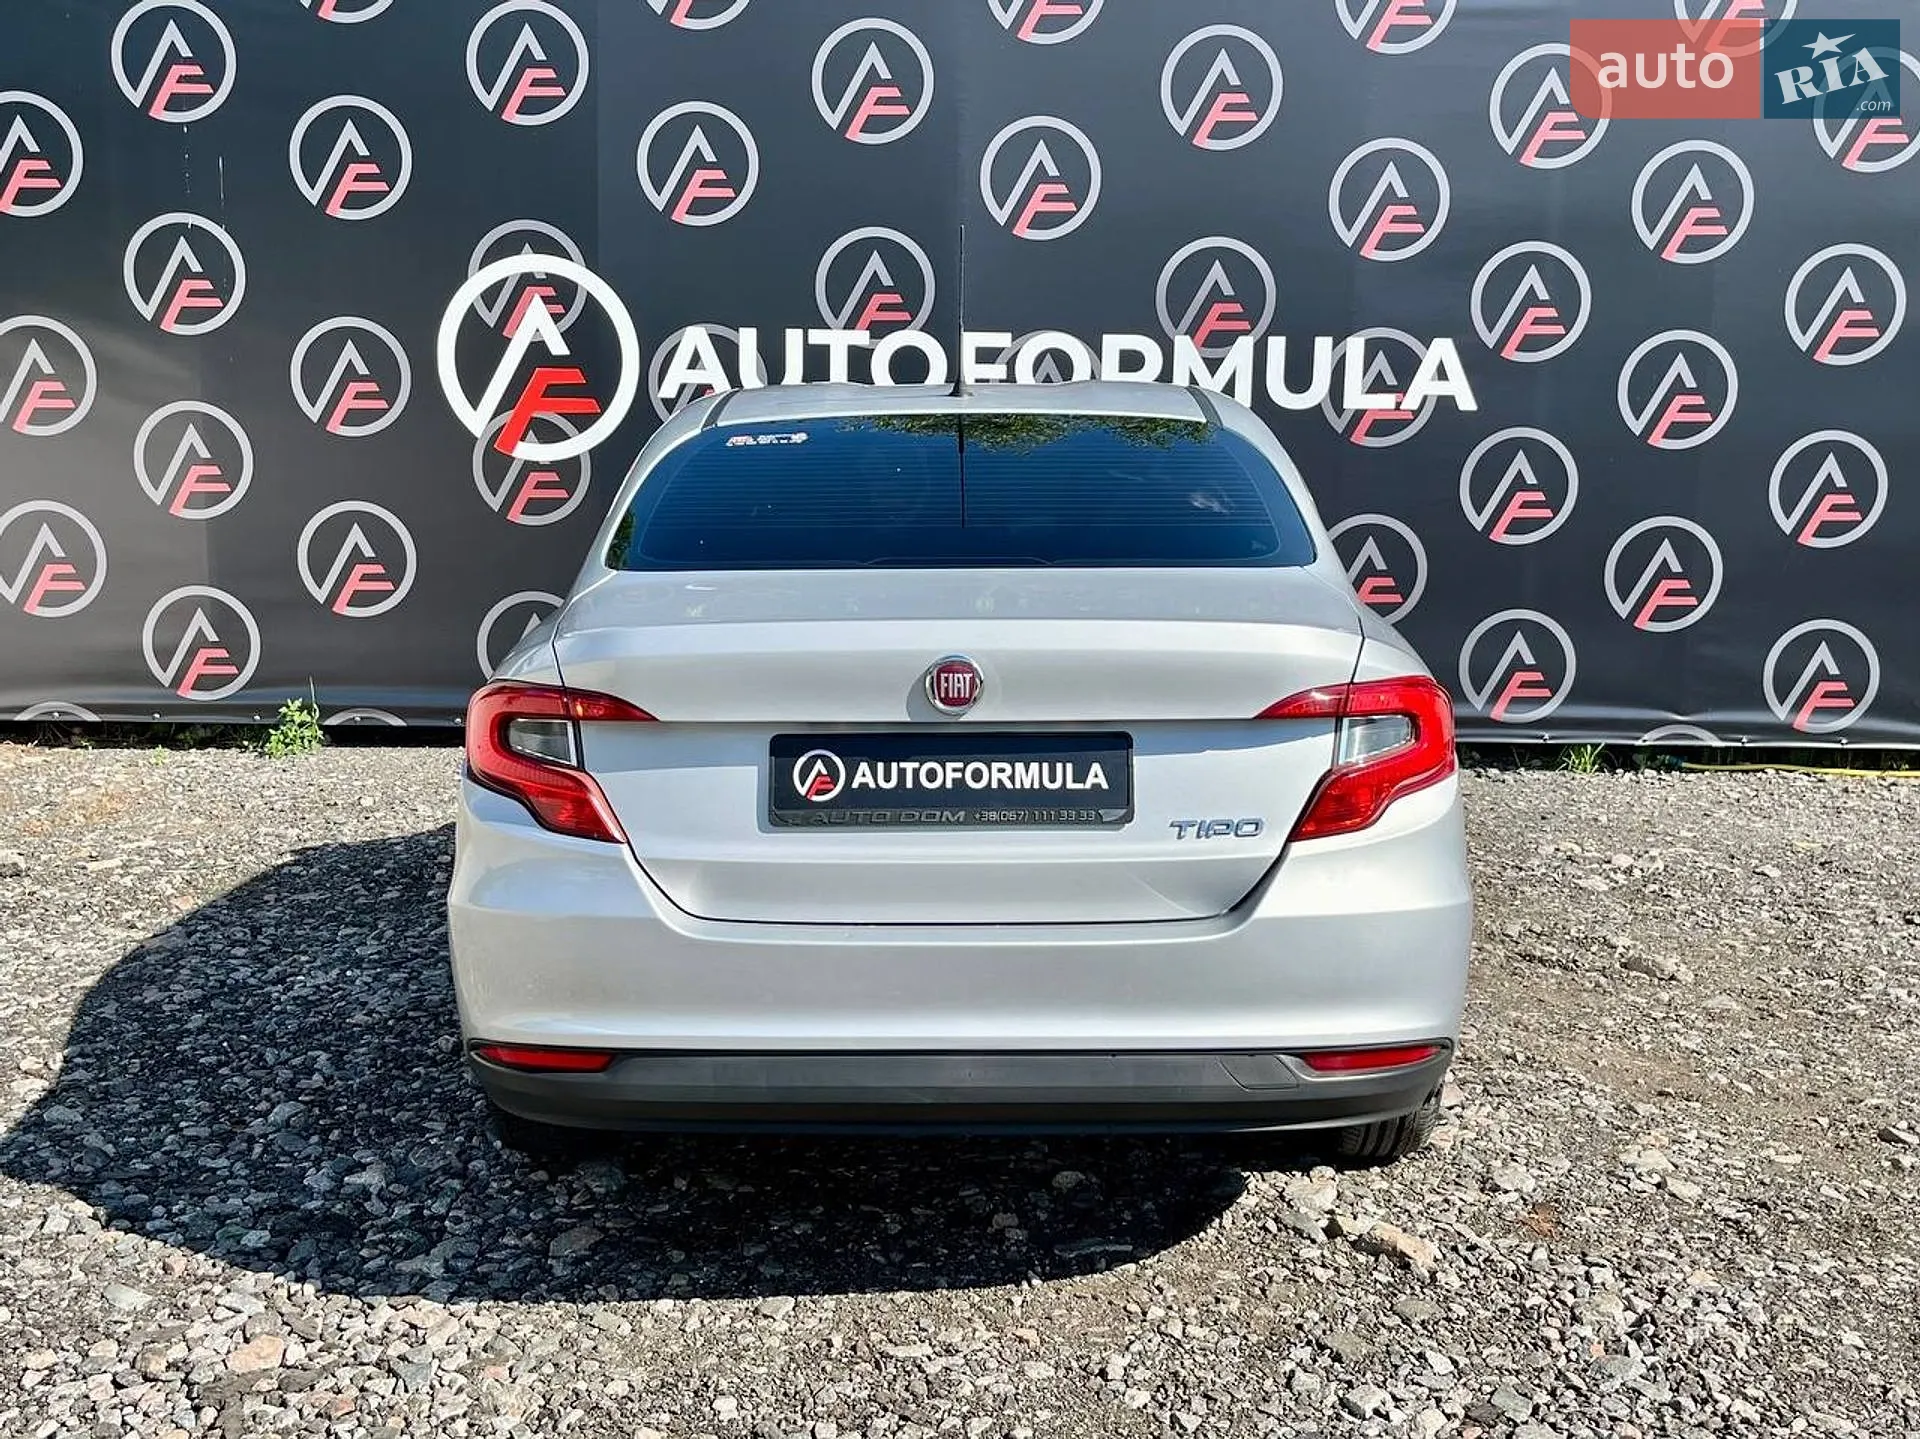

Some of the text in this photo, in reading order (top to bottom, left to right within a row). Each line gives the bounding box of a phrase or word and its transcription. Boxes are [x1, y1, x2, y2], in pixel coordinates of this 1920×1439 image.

[657, 326, 1478, 411] AUTOFORMULA
[940, 673, 973, 698] FIAT
[851, 761, 1110, 789] AUTOFORMULA
[900, 810, 967, 823] DOM
[1169, 819, 1263, 839] TIPO
